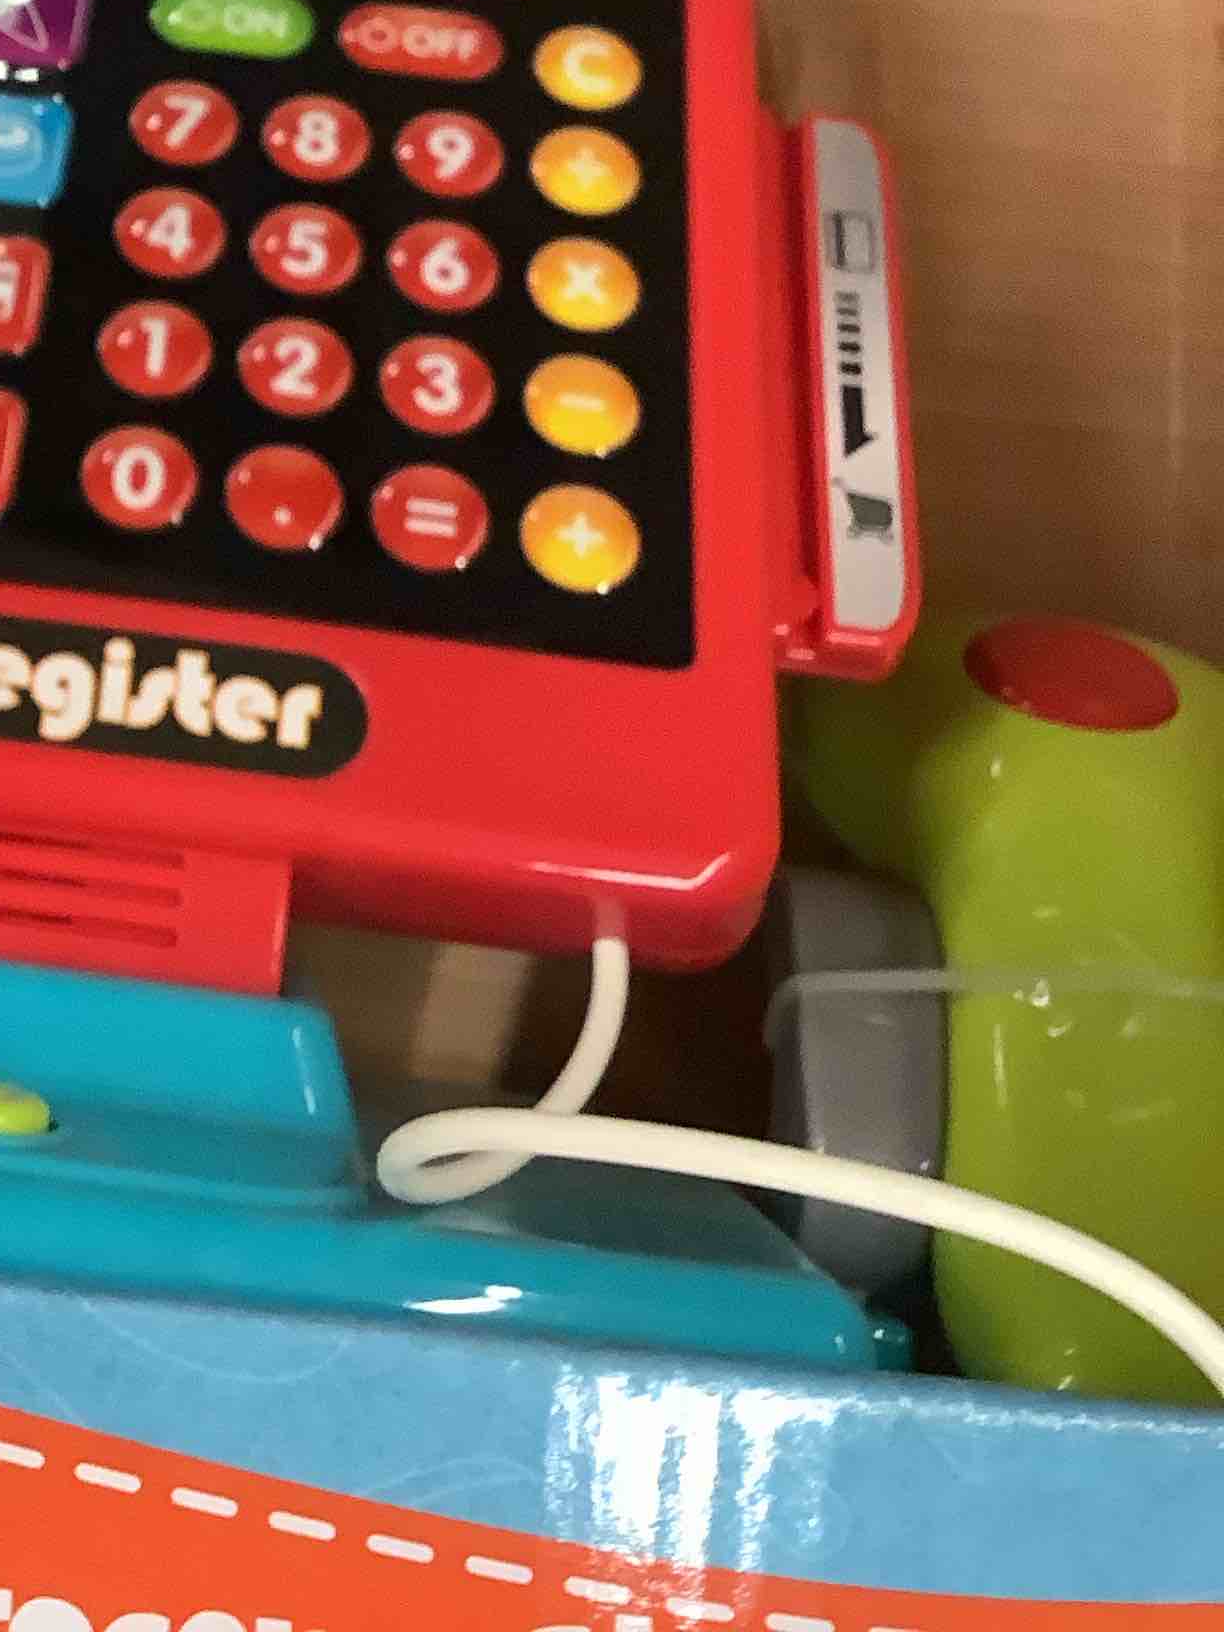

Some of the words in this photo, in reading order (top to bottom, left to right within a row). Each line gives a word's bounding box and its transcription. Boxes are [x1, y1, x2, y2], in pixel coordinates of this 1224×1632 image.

[223, 1, 290, 39] ON
[402, 22, 477, 64] OFF
[164, 93, 209, 148] 7
[292, 109, 340, 165] 8
[425, 123, 476, 180] 9
[145, 203, 194, 259] 4
[279, 218, 330, 279] 5
[419, 236, 471, 296] 6
[138, 316, 170, 378] 1
[270, 333, 320, 399] 2
[412, 351, 464, 416] 3
[110, 442, 167, 512] 0
